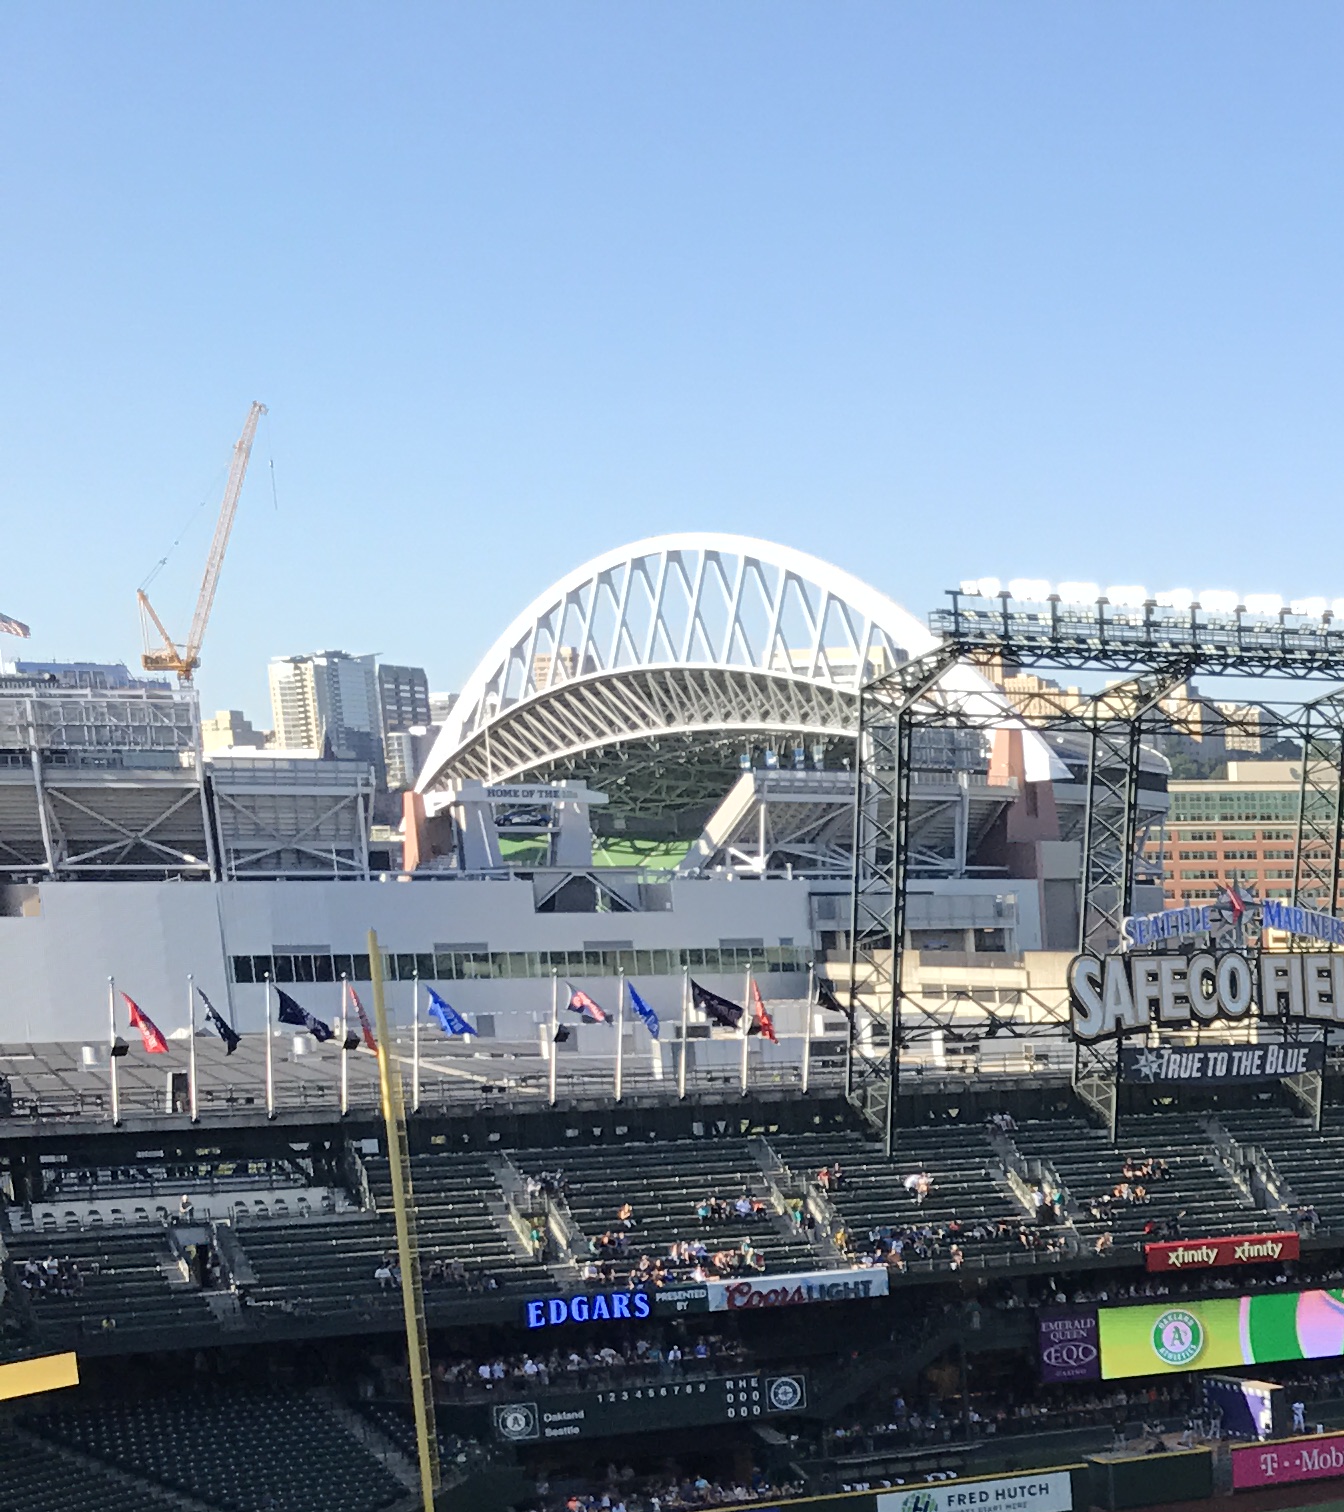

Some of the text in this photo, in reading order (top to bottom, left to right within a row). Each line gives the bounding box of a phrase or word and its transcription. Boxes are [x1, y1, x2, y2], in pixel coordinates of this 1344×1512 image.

[487, 789, 560, 798] HOME OF THE
[1122, 906, 1211, 946] SEATTLE
[1069, 952, 1251, 1042] SAFECO
[1160, 1045, 1309, 1079] TRUE TO THE BLUE
[1168, 1241, 1283, 1267] xfinity xfinity
[655, 1289, 707, 1301] PRESENTED
[725, 1280, 873, 1309] Coors LIGHT
[527, 1293, 650, 1328] EDGAR'S
[677, 1303, 688, 1311] BY
[1041, 1318, 1095, 1333] EMERALD
[1158, 1313, 1195, 1330] OAKLAND
[1050, 1330, 1088, 1343] QUEEN
[1050, 1344, 1093, 1366] EQC
[1159, 1344, 1197, 1361] ATHLETICS
[726, 1377, 759, 1389] R H E
[726, 1391, 760, 1403] 0 0 0
[543, 1410, 585, 1423] Oakland
[727, 1405, 761, 1418] 0 0 0
[544, 1425, 580, 1437] Seattle
[948, 1483, 1049, 1506] FRED HUTCH
